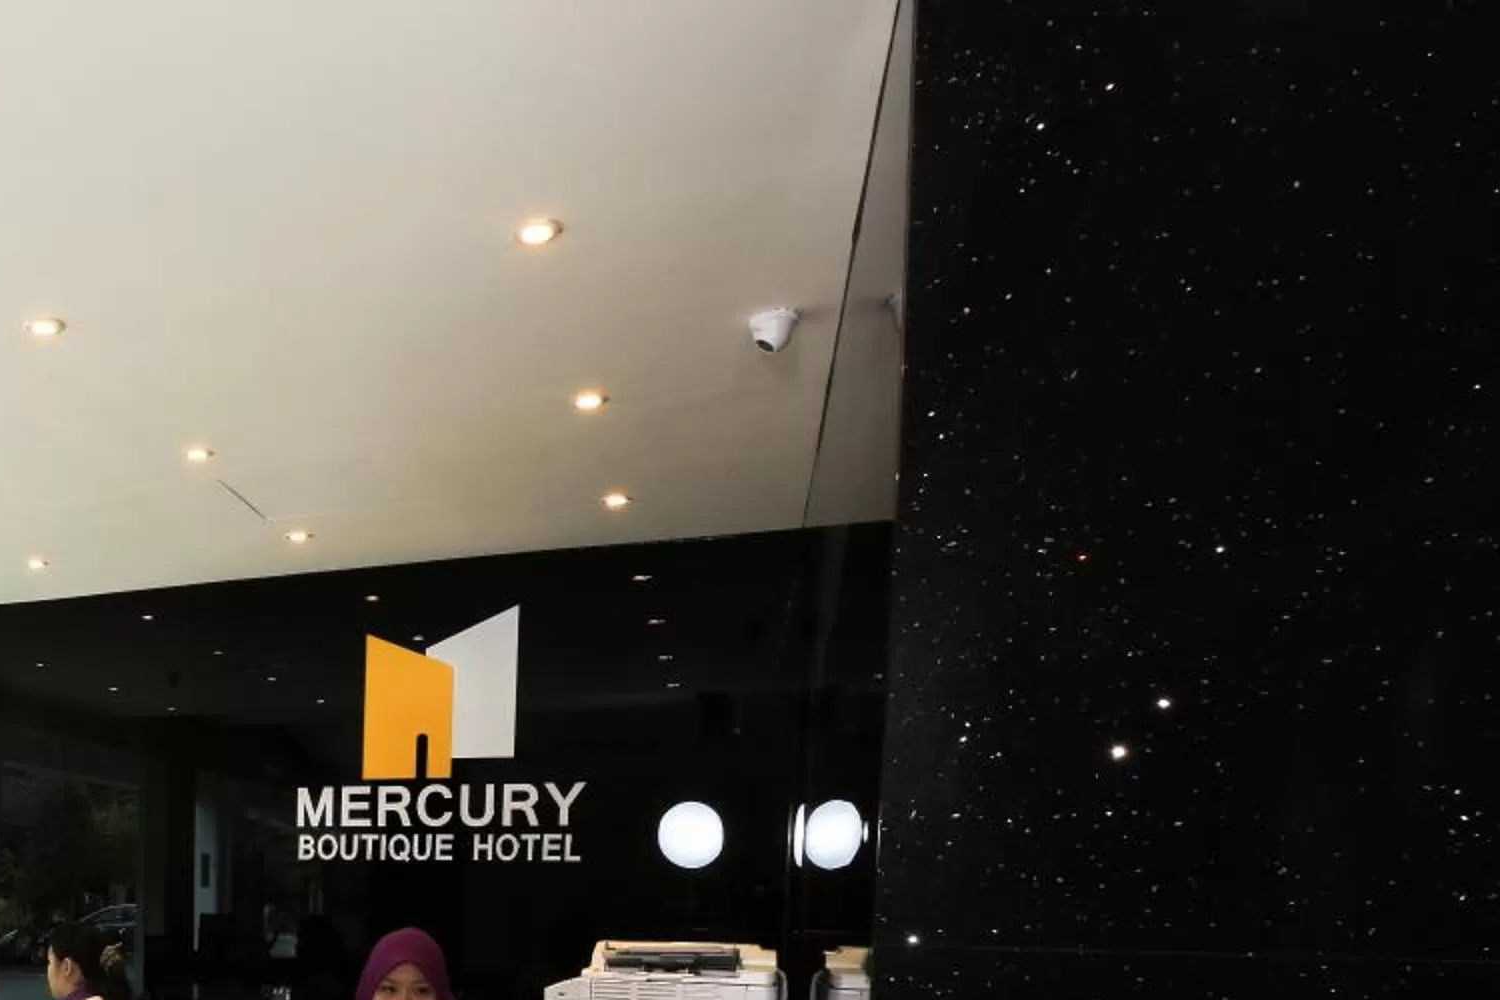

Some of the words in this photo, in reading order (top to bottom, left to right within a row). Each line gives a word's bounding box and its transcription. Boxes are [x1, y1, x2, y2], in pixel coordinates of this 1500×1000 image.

[296, 781, 587, 828] MERCURY
[297, 833, 454, 863] BOUTIQUE
[473, 833, 581, 862] HOTEL
